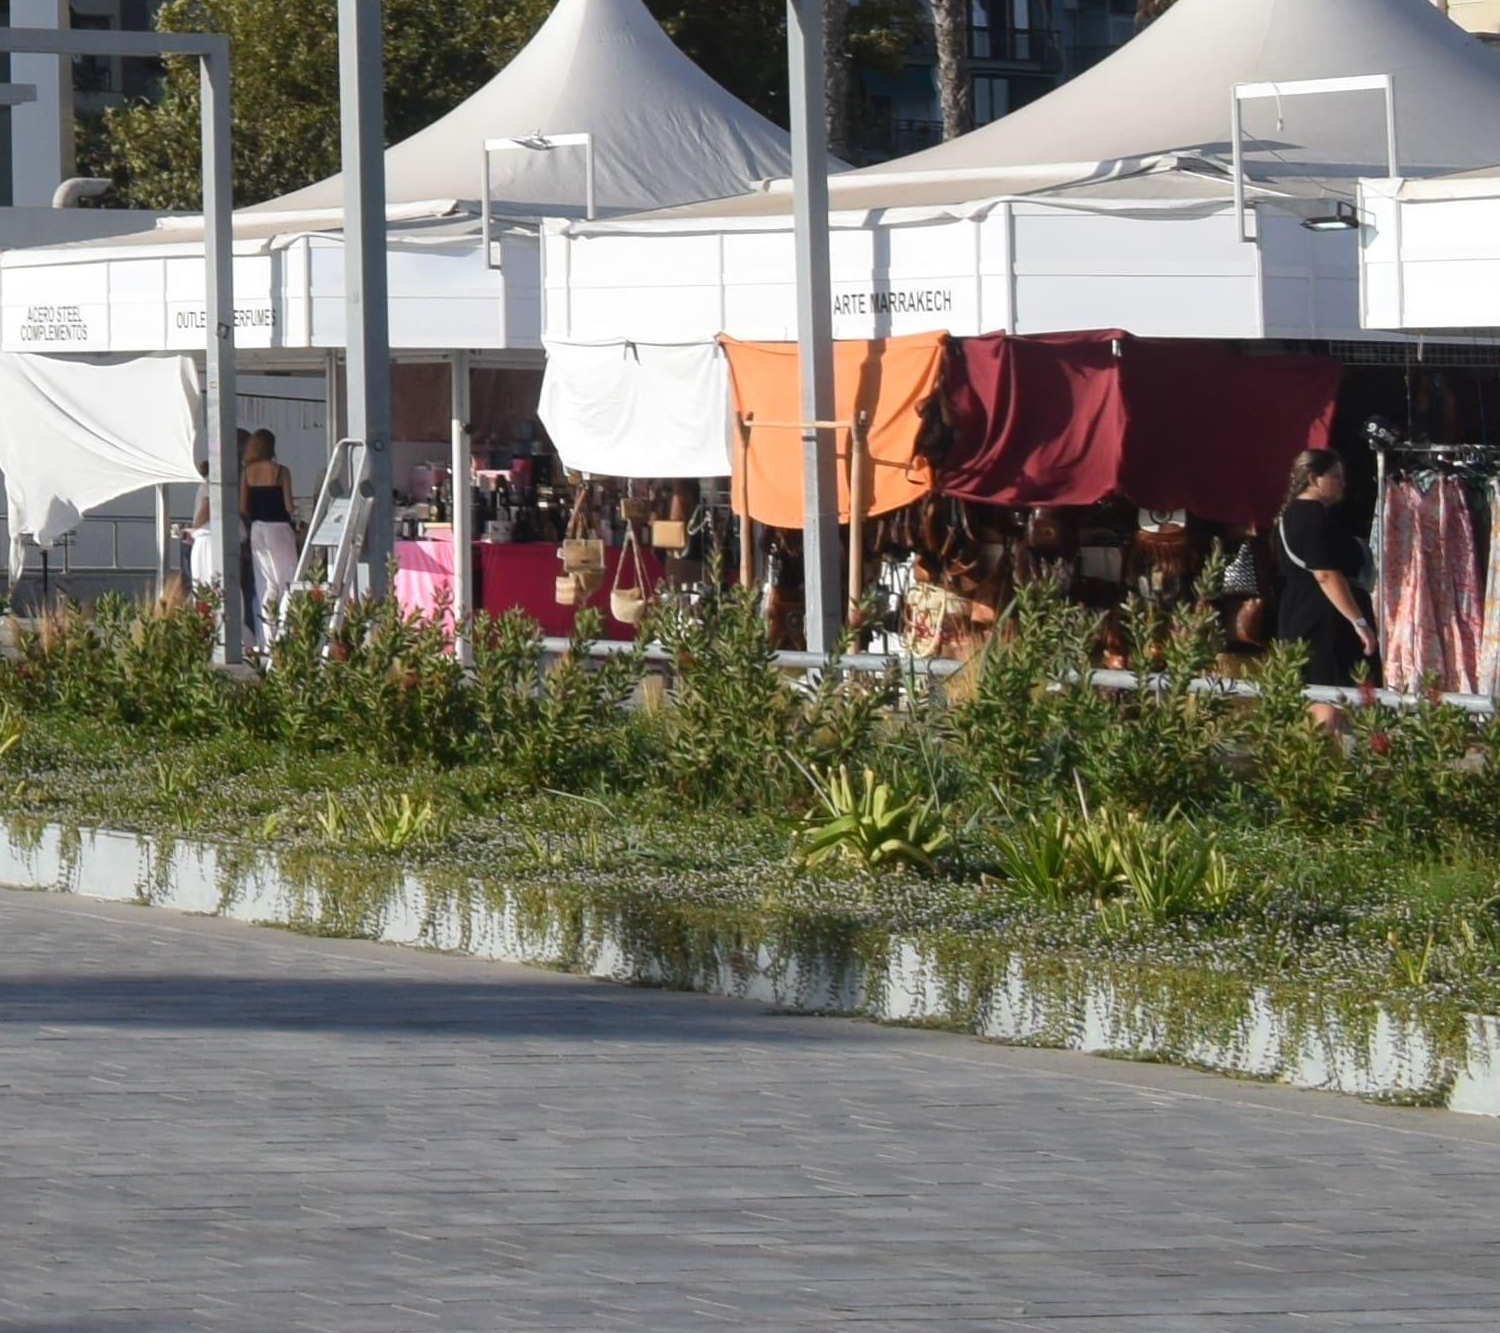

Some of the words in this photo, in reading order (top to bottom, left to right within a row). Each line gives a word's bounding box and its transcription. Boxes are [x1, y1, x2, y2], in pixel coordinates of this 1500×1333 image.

[833, 293, 866, 315] ARTE
[870, 290, 953, 314] MARRAKECH
[27, 306, 55, 323] ACERO
[56, 305, 82, 323] STEEL
[176, 311, 206, 329] OUTLE
[233, 308, 277, 327] ERFUMES
[20, 324, 88, 341] COMPLEMENTOS
